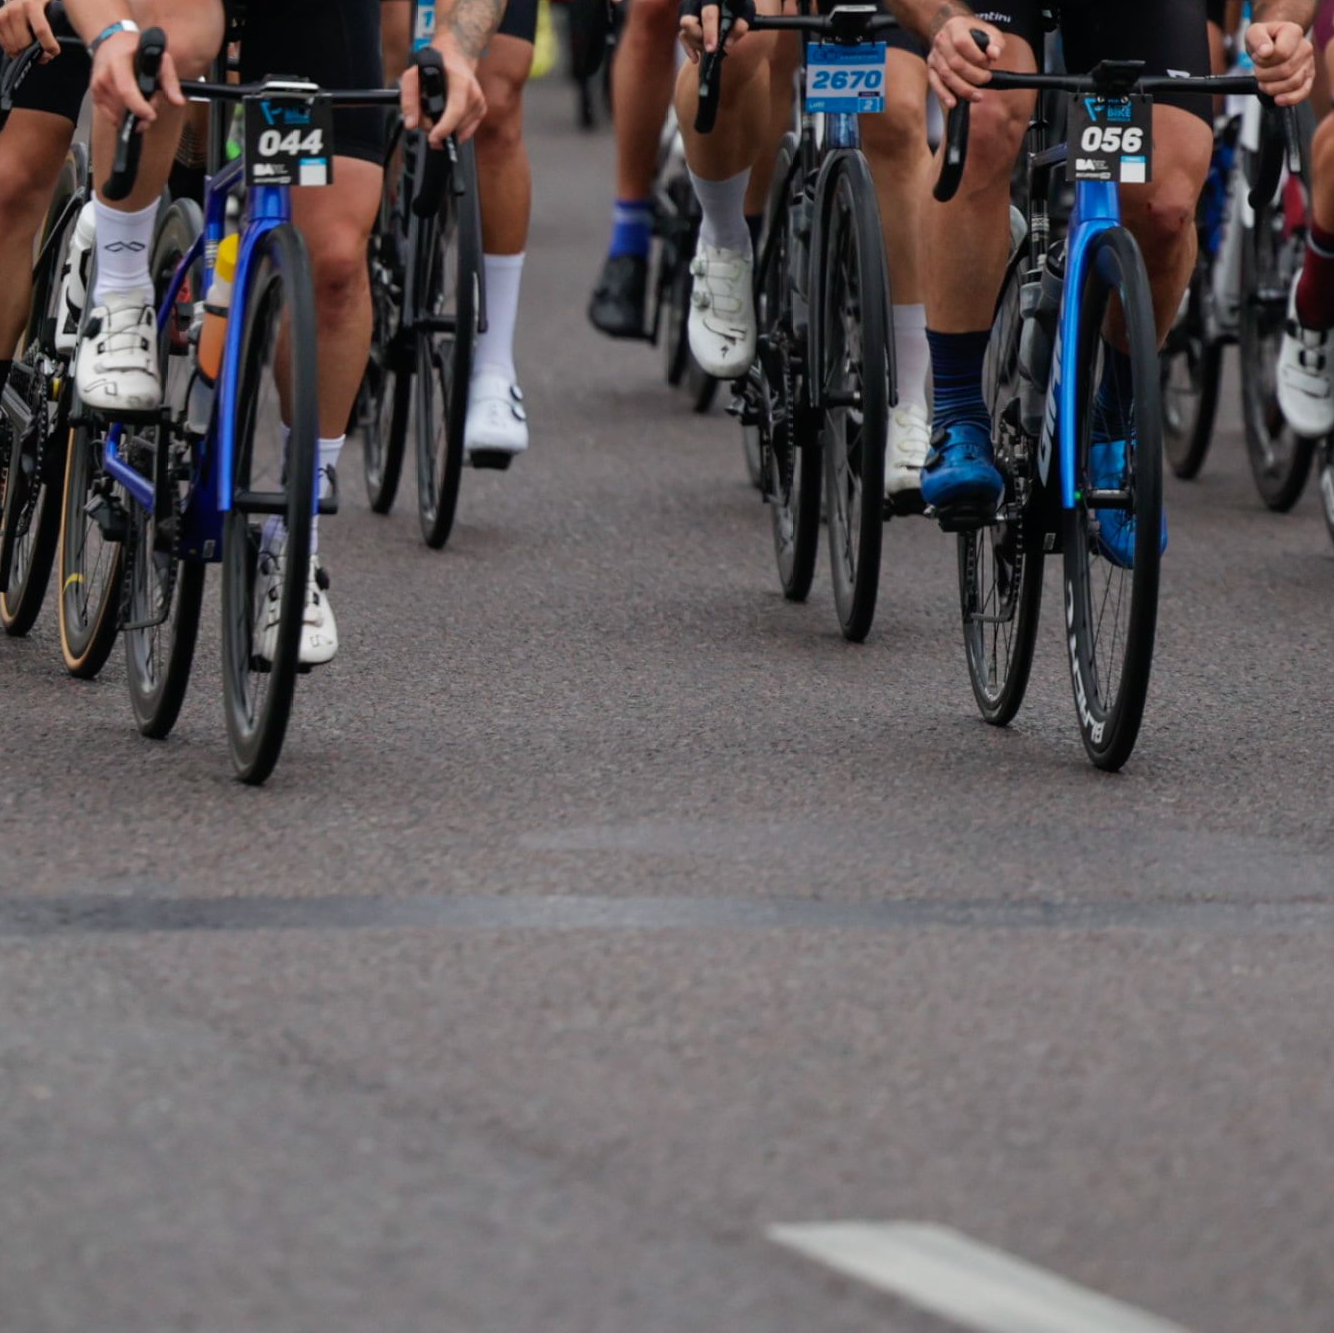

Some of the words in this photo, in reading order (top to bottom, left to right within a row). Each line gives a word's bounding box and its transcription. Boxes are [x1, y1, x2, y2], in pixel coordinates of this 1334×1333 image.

[812, 70, 882, 89] 2670
[258, 128, 323, 156] 044
[1081, 126, 1143, 153] 056
[1076, 158, 1095, 171] BA
